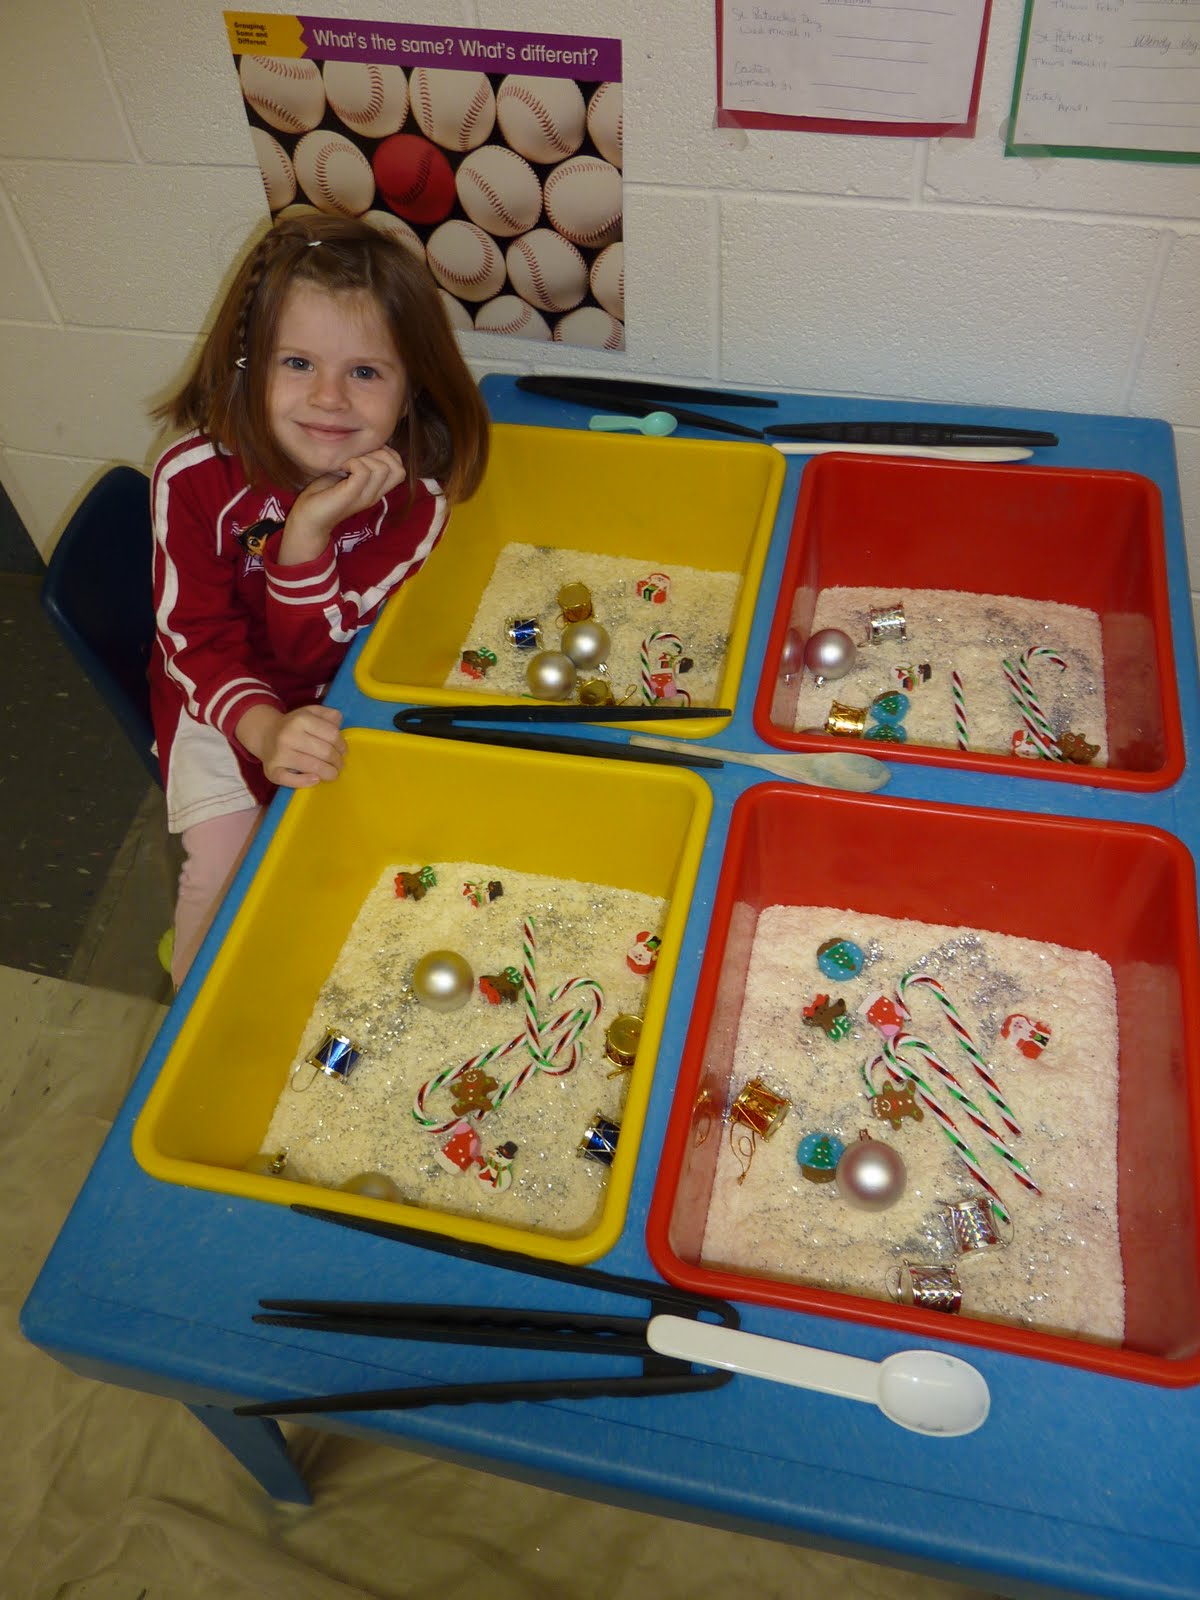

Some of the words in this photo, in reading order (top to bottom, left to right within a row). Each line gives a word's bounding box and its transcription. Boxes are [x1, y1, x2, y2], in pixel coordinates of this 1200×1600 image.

[235, 29, 254, 37] Same
[237, 37, 267, 46] Different
[312, 29, 367, 50] What's
[371, 33, 396, 52] the
[401, 38, 454, 55] same?
[458, 39, 516, 61] What's
[520, 43, 599, 66] different?
